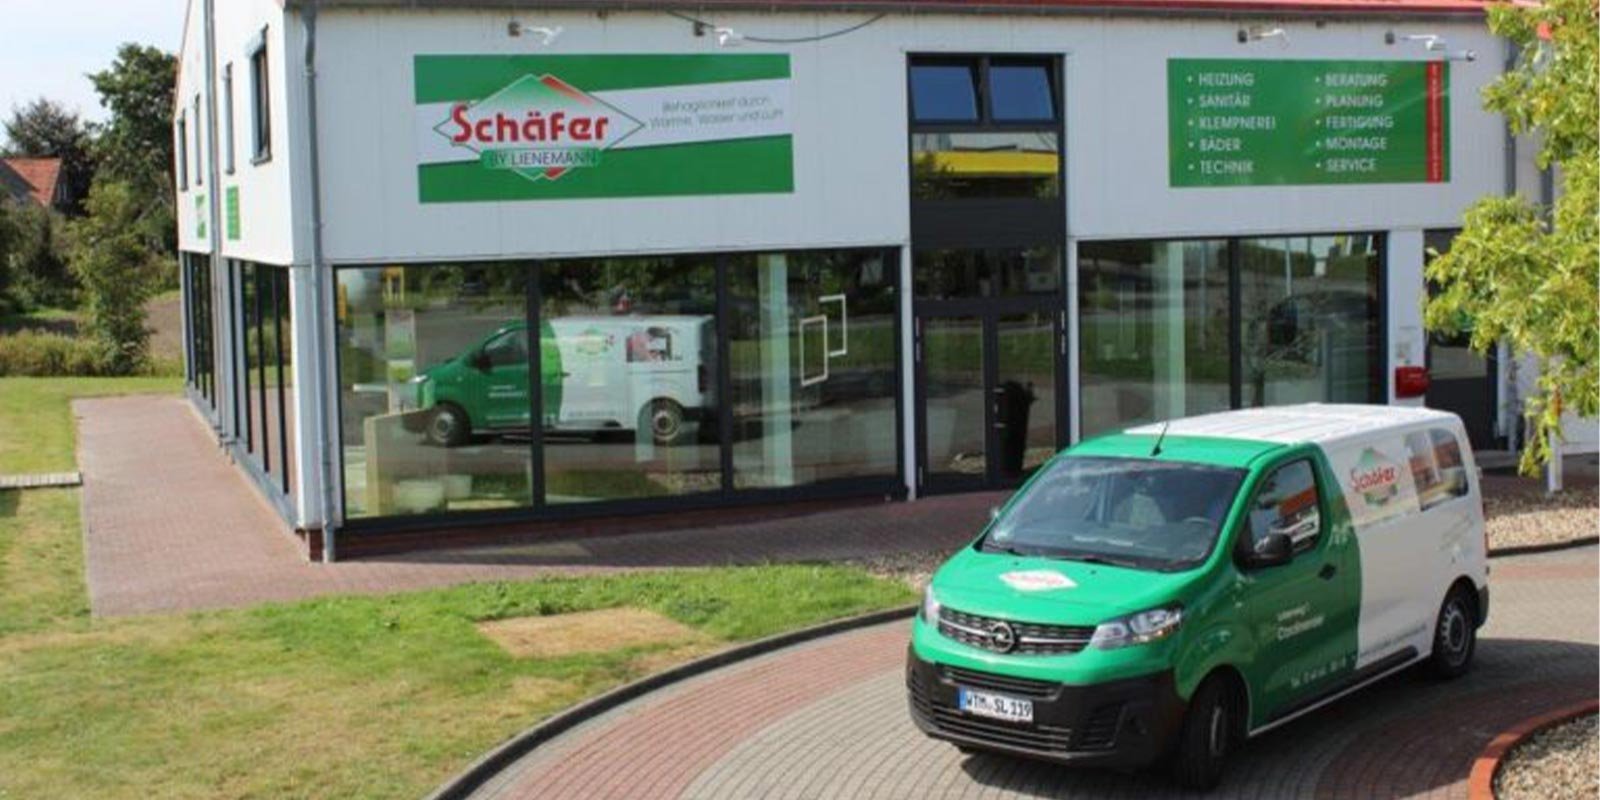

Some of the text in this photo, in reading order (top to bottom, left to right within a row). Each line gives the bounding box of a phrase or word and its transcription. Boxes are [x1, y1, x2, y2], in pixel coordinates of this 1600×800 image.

[1199, 72, 1254, 86] HEIZUNG
[1325, 73, 1388, 87] BERATUNG
[1199, 92, 1251, 108] SANITÄR
[1325, 94, 1384, 108] PLANUNG
[452, 103, 609, 143] Schäfer
[1199, 115, 1276, 131] KLEMPNEREI
[1326, 115, 1394, 129] FERTIGUNG
[1199, 135, 1241, 151] BÄDER
[1326, 137, 1387, 151] MONTAGE
[510, 150, 598, 166] LIENEMANN
[1326, 158, 1377, 173] SERVICE
[1199, 159, 1254, 175] TECHNIK
[994, 697, 1009, 714] SL
[1010, 701, 1032, 717] 119
